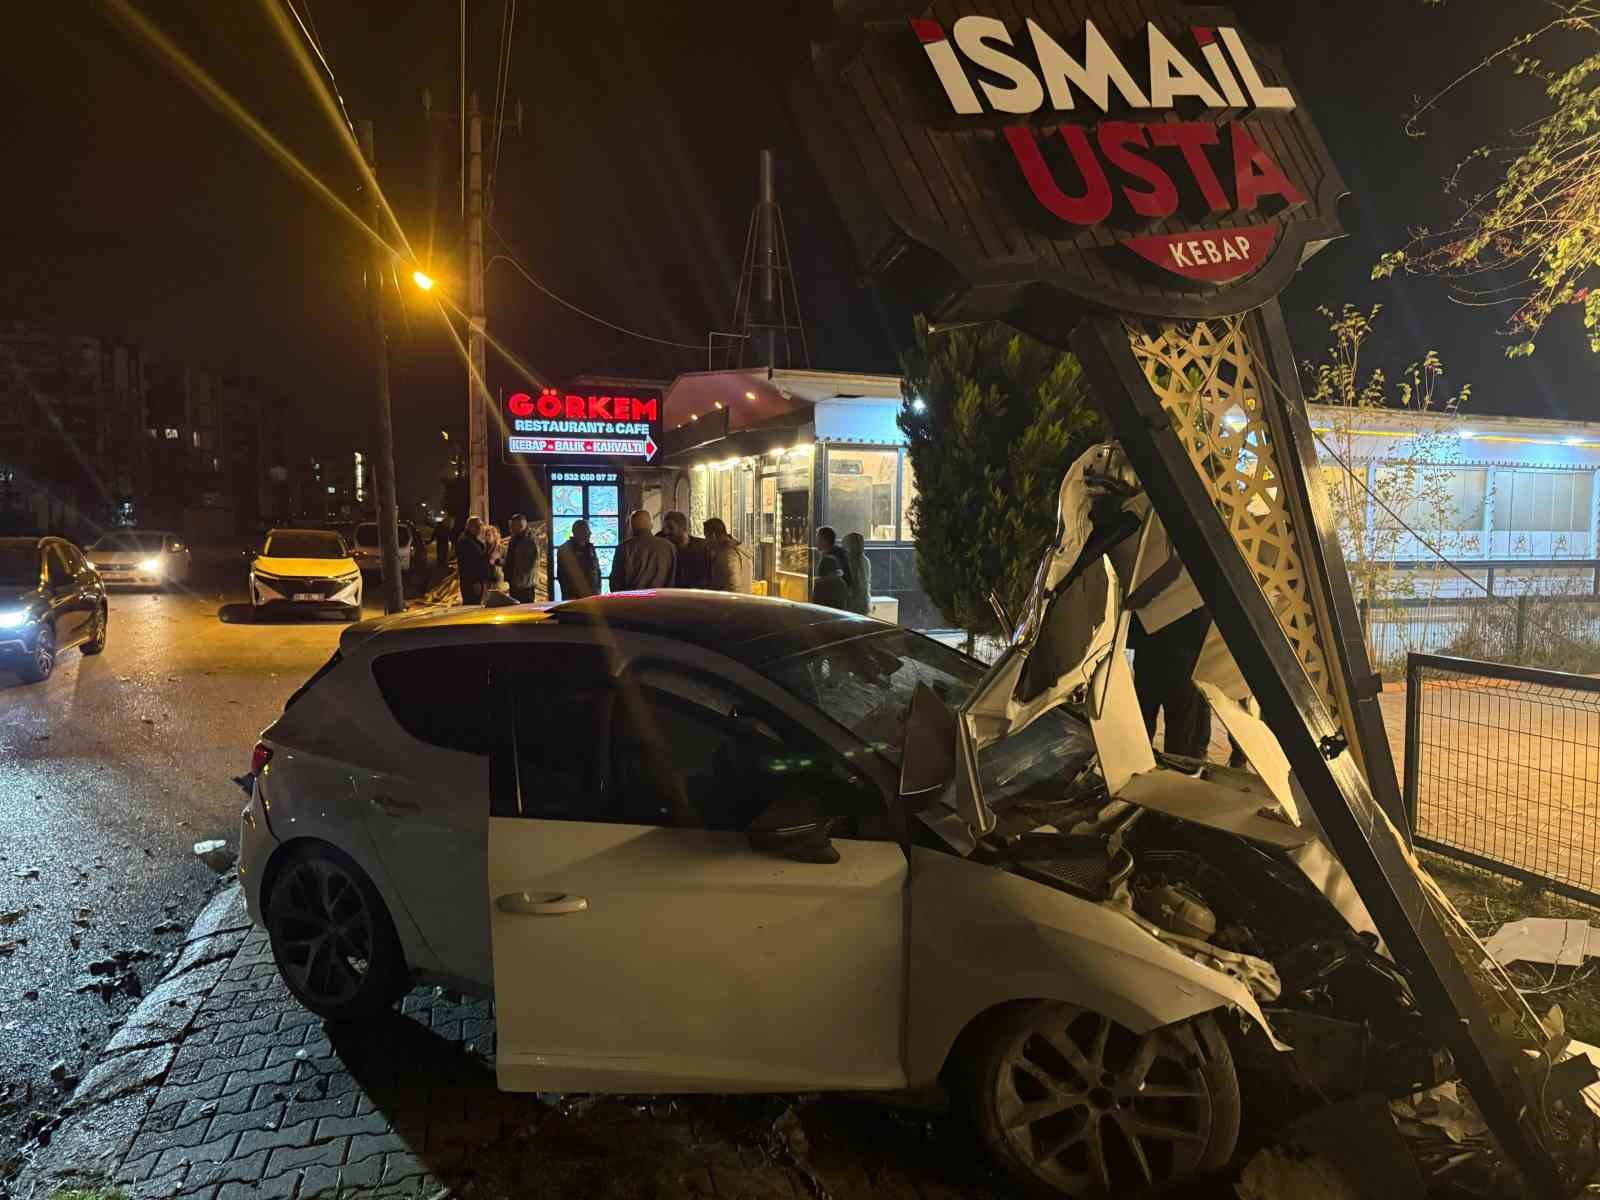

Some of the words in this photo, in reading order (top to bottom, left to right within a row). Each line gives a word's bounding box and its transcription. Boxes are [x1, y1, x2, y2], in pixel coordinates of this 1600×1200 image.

[1003, 121, 1309, 225] USTA
[1169, 235, 1252, 268] KEBAP
[508, 388, 657, 421] GÖRKEM
[511, 440, 546, 451] KEBAP
